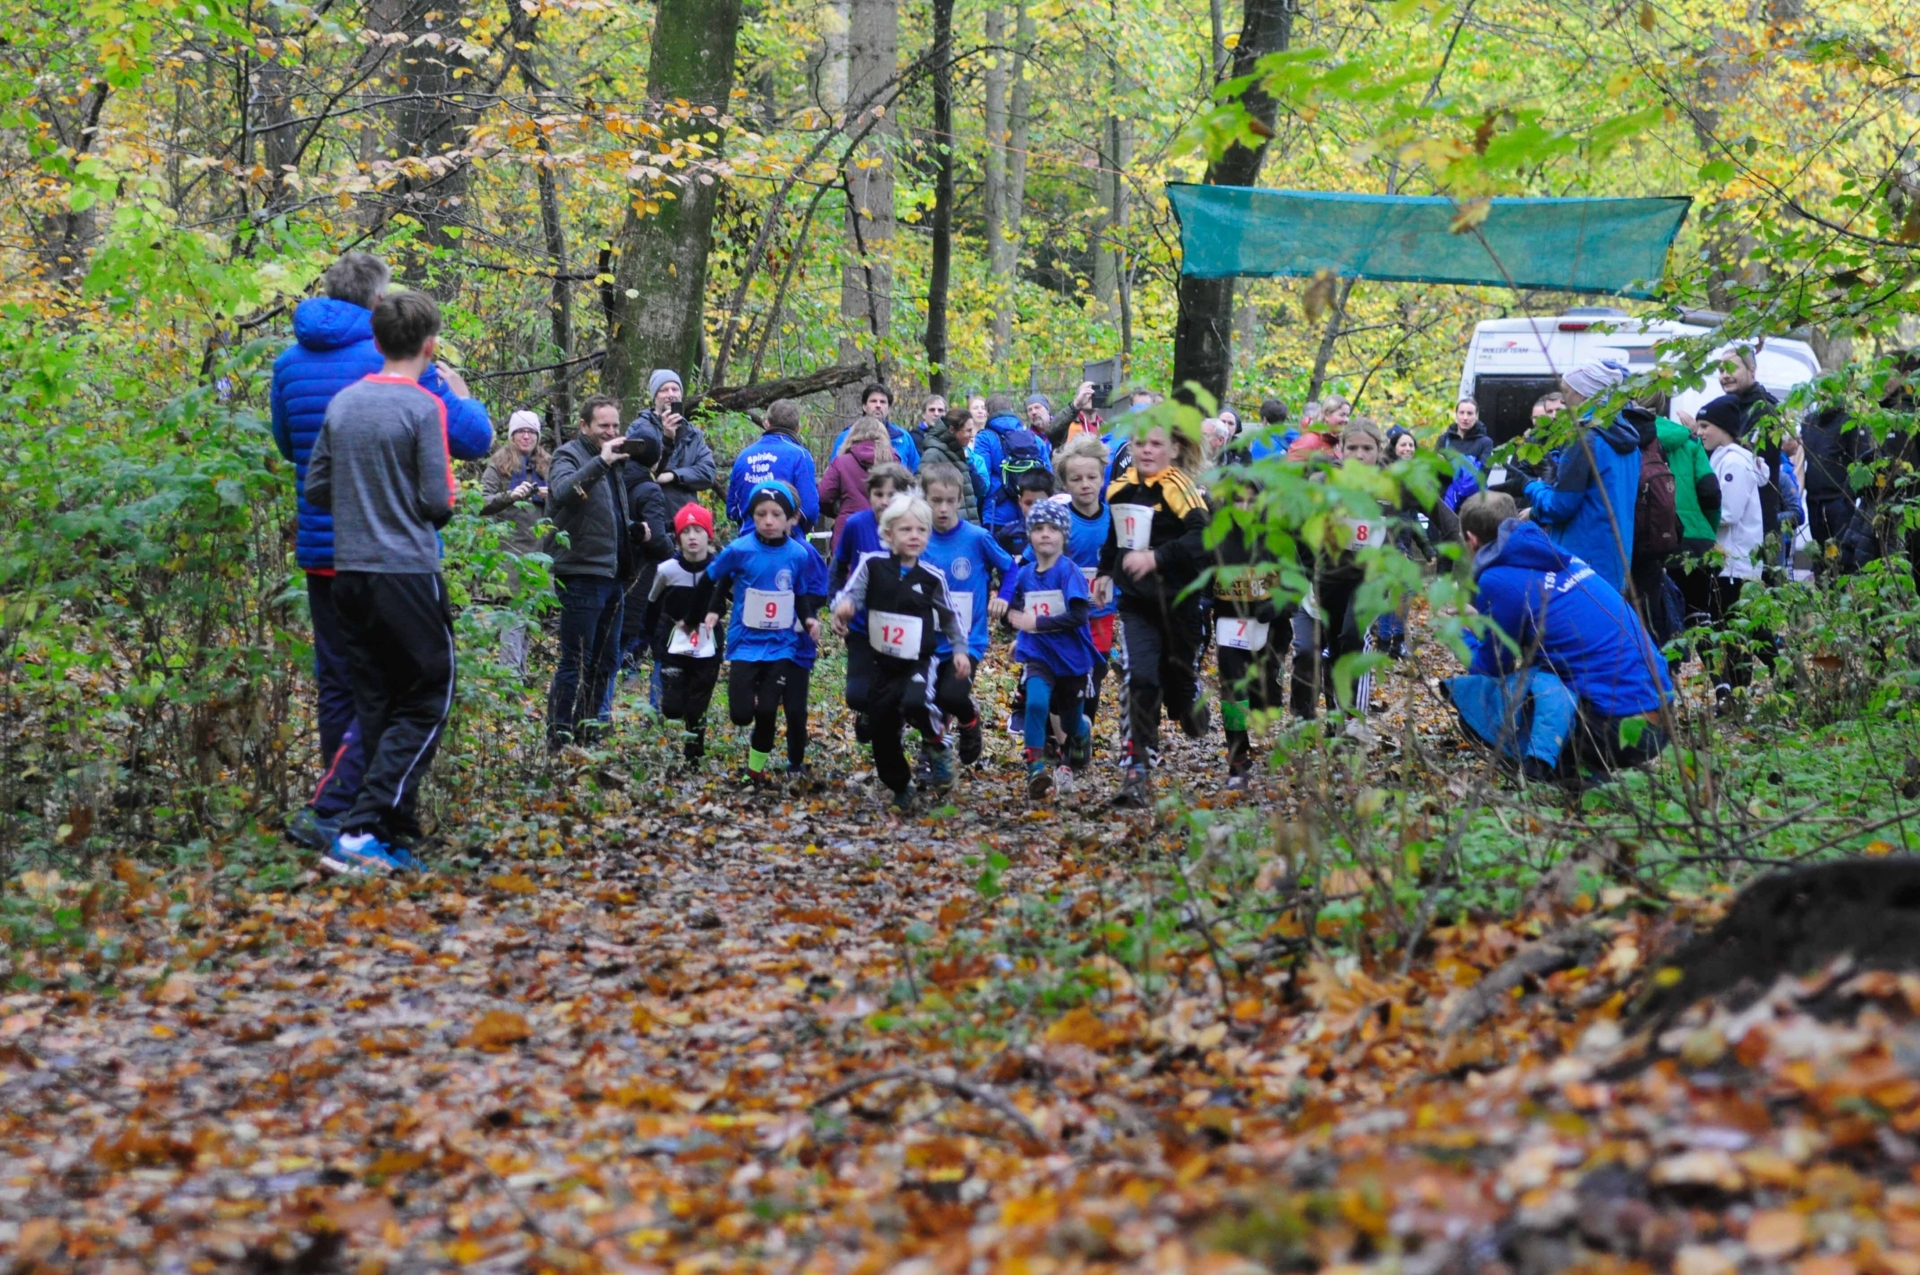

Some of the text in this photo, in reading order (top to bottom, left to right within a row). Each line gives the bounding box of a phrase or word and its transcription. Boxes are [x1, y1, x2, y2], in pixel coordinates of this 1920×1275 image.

[1356, 524, 1368, 541] 8
[765, 602, 777, 618] 9
[882, 625, 905, 645] 12
[1236, 620, 1248, 637] 7
[690, 631, 699, 648] 4
